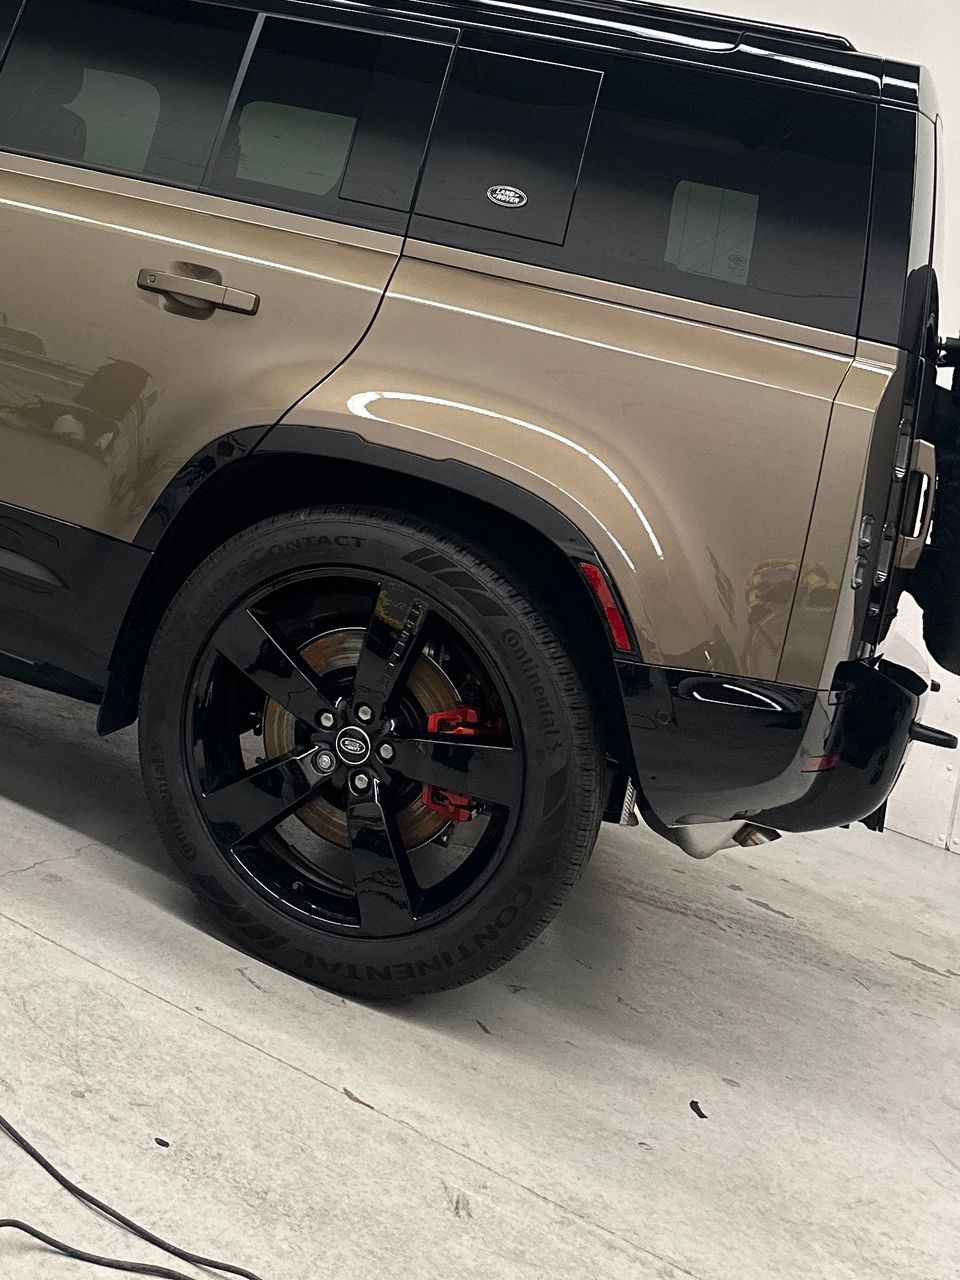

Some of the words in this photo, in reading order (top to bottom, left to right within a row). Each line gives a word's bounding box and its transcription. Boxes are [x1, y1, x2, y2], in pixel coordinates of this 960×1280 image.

[495, 188, 515, 197] LAND
[496, 194, 520, 204] ROVER
[501, 627, 561, 737] Continental
[299, 884, 533, 983] CONTINENTAL
